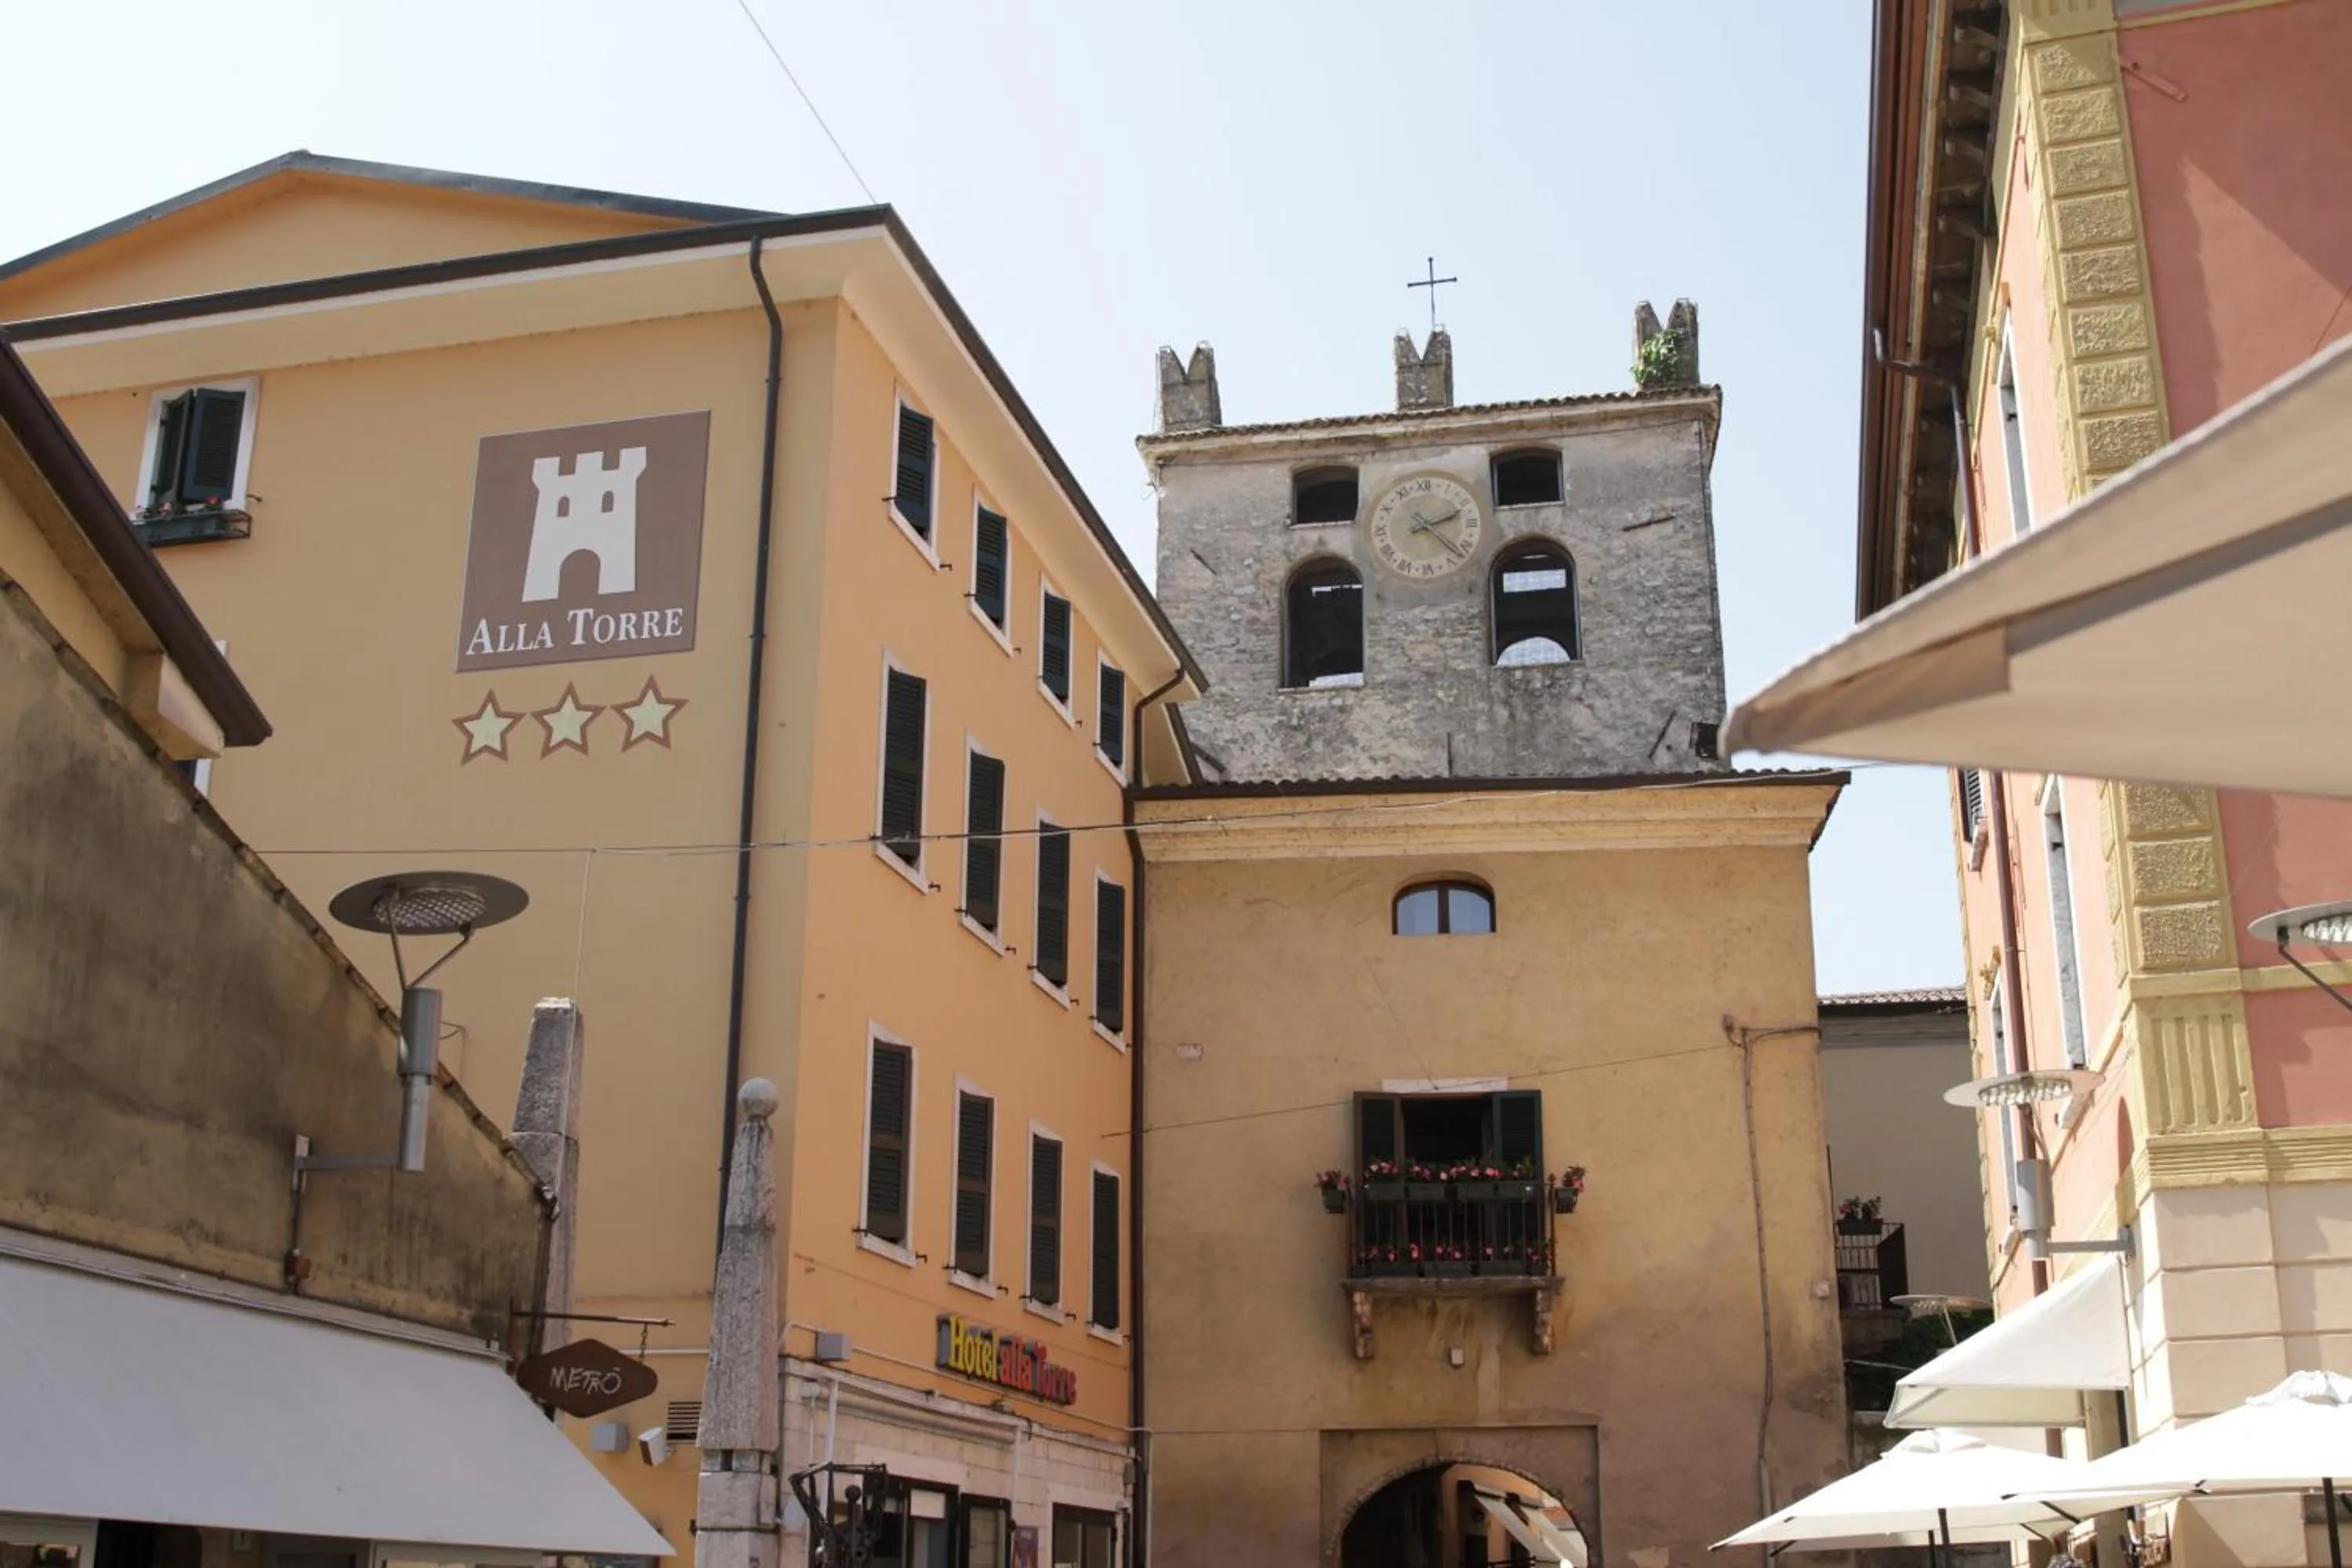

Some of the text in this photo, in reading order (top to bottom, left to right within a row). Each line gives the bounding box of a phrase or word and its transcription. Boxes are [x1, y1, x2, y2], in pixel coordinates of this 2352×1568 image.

[1466, 518, 1478, 528] III
[466, 608, 684, 655] ALLA TORRE
[949, 1316, 998, 1381] Hotel
[1000, 1335, 1033, 1390] alla
